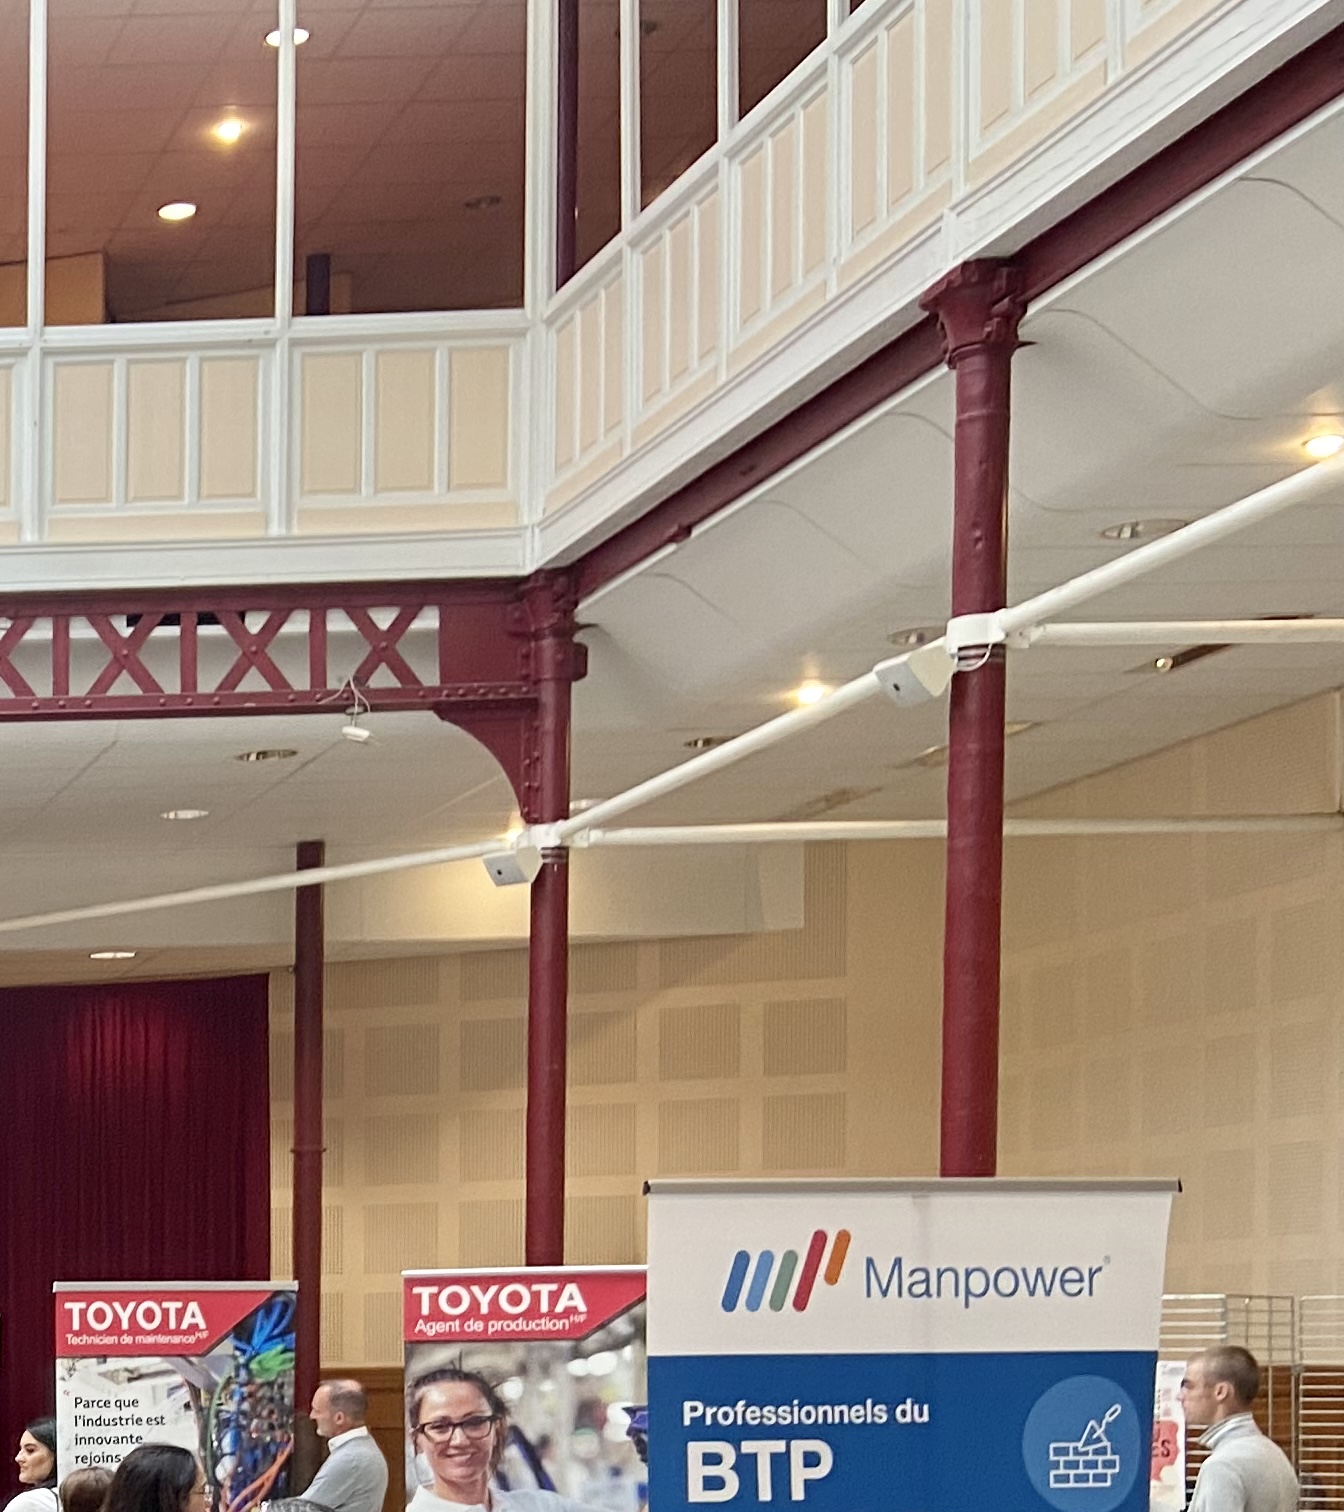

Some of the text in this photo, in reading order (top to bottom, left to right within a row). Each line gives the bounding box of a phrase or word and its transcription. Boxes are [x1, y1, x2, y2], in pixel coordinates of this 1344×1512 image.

[865, 1256, 1103, 1309] Manpower
[412, 1283, 588, 1316] TOYOTA
[64, 1301, 207, 1331] TOYOTA
[414, 1318, 460, 1336] Agent
[464, 1318, 484, 1333] de
[487, 1317, 570, 1335] production
[65, 1334, 118, 1346] Technicien
[120, 1334, 133, 1345] de
[135, 1334, 196, 1345] maintenance
[74, 1397, 140, 1411] Parce que
[683, 1398, 930, 1426] Professionnels du
[74, 1415, 166, 1427] l'industrie est
[75, 1434, 143, 1446] innovante
[687, 1439, 834, 1503] BTP
